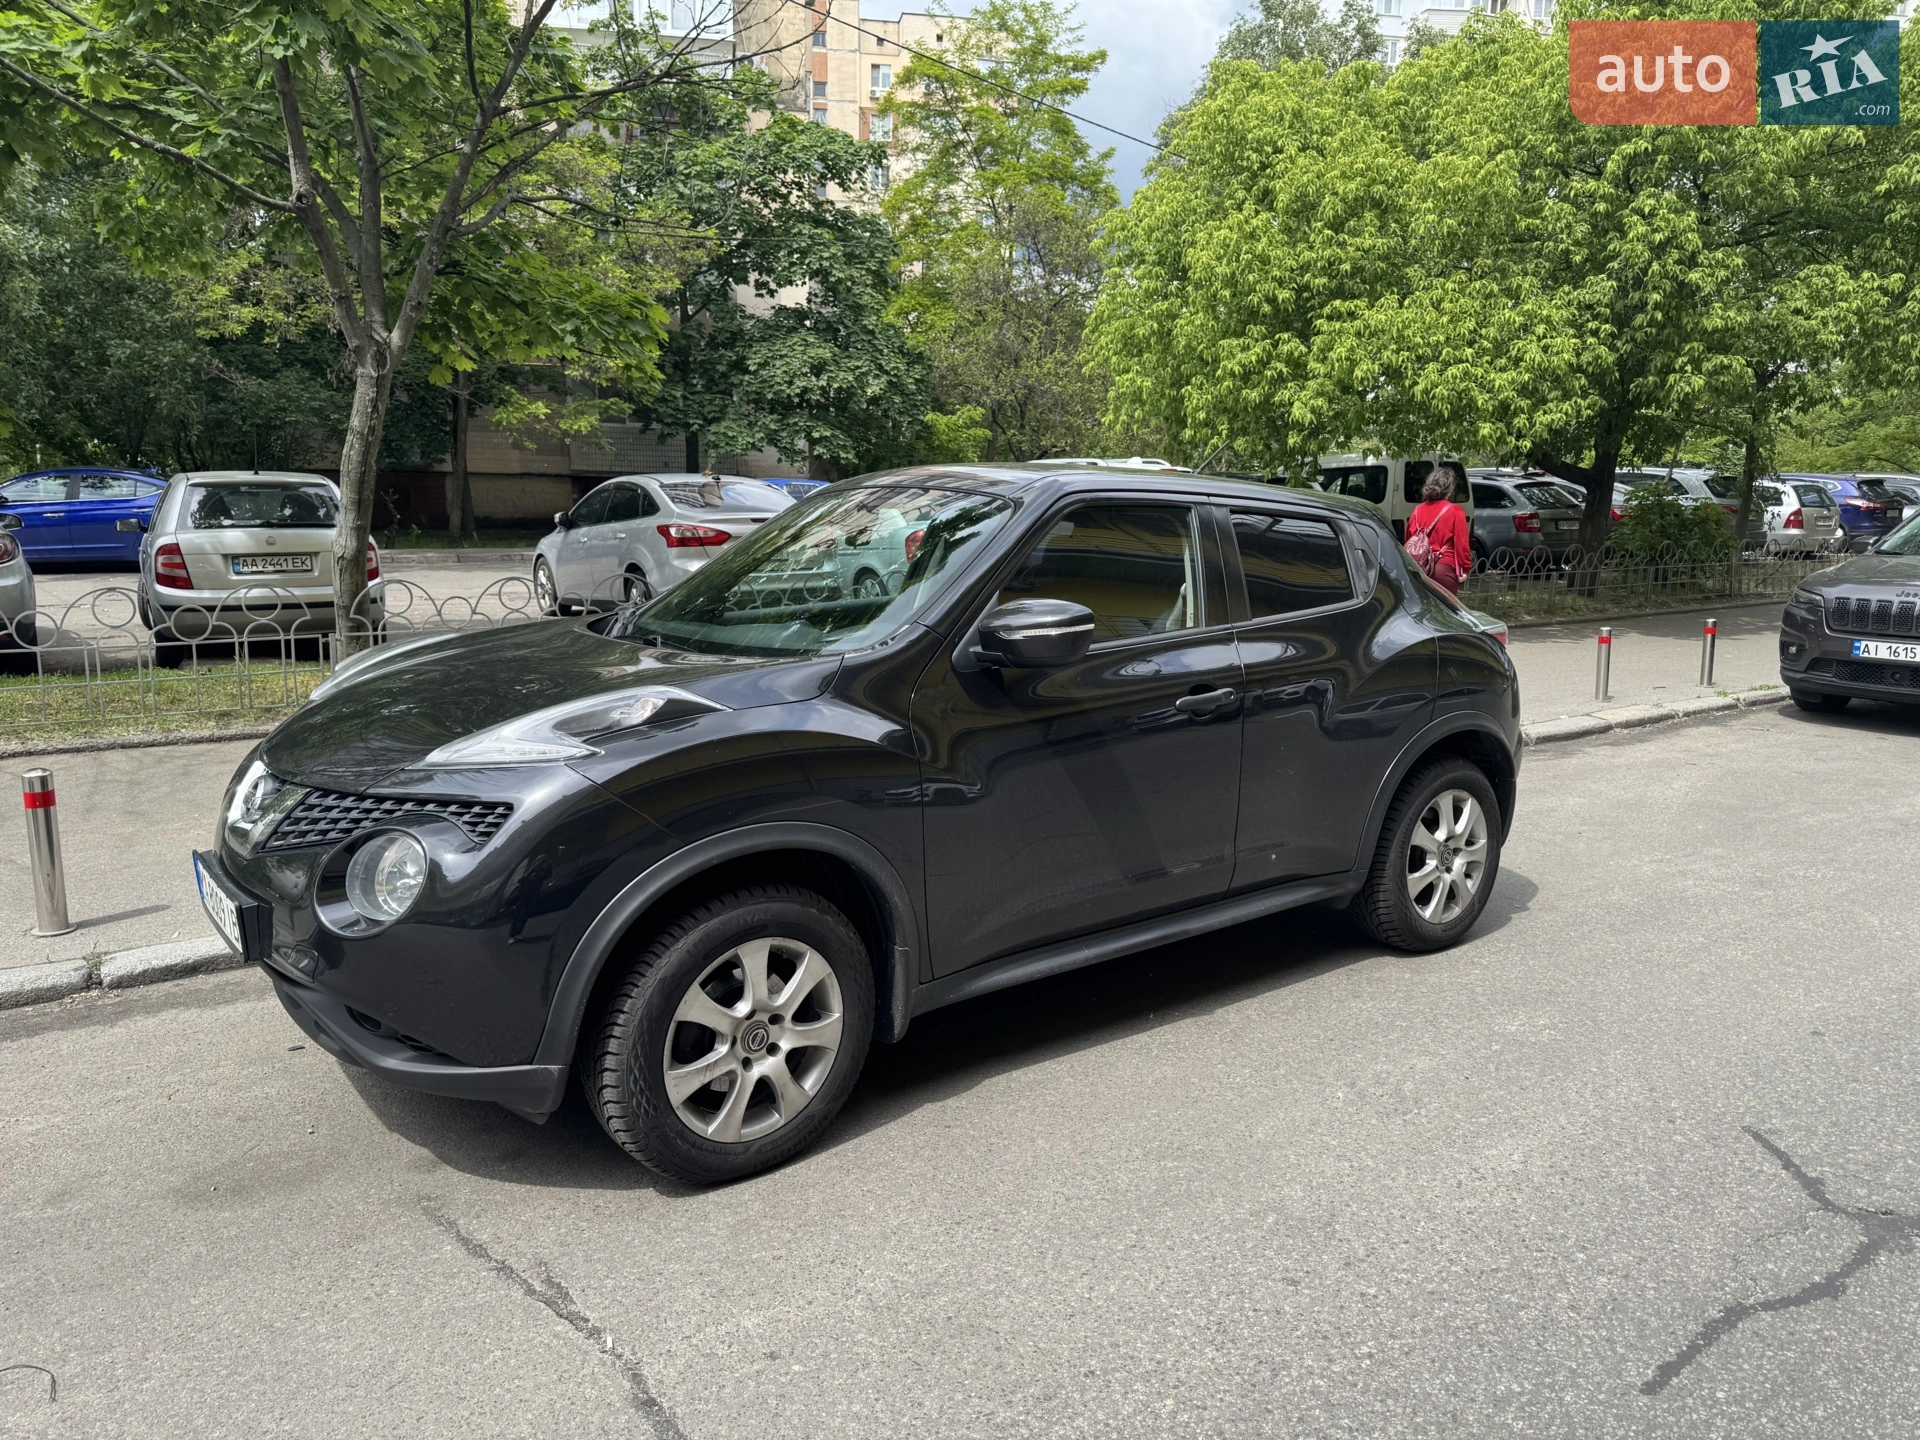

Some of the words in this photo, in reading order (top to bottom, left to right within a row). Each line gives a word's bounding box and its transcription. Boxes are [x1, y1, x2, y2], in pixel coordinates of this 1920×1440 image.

[241, 558, 259, 570] AA
[261, 557, 289, 569] 2441
[291, 557, 310, 568] EK
[1895, 590, 1920, 600] Jee
[1861, 643, 1879, 656] AI
[1886, 645, 1917, 659] 1615
